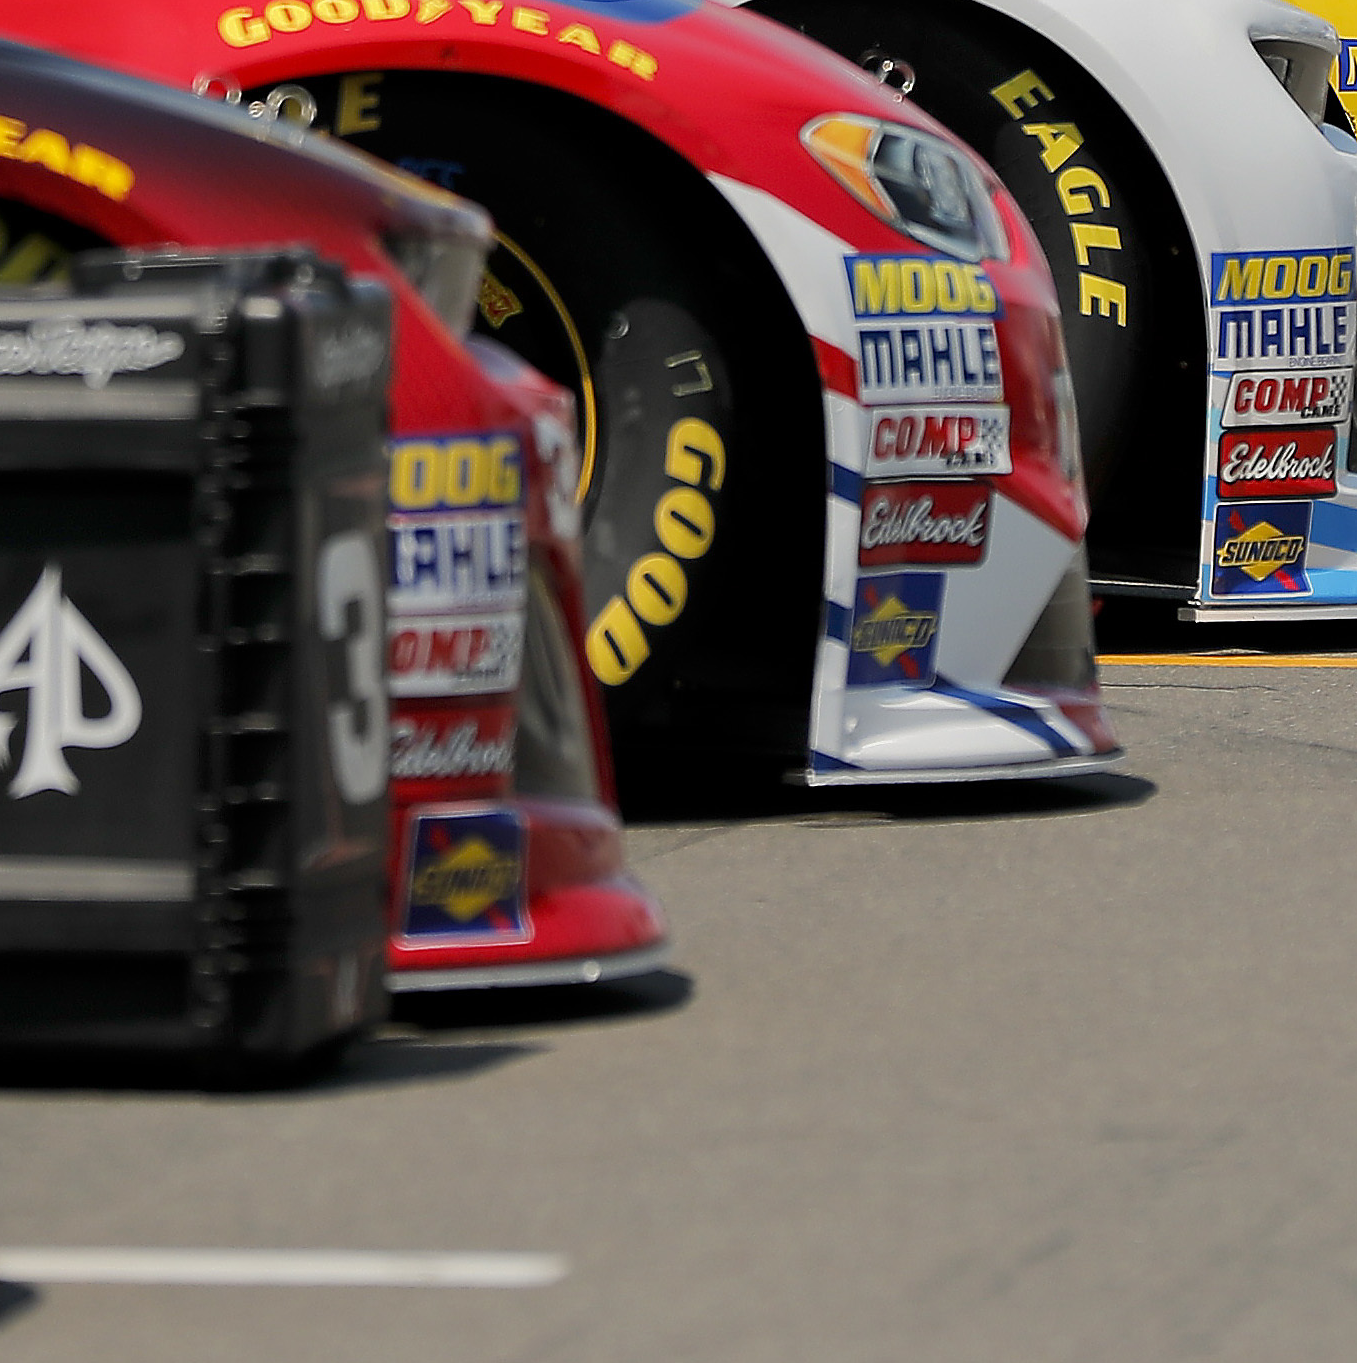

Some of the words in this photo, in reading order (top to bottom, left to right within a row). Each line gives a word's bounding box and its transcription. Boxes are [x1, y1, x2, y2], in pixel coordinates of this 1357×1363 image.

[990, 68, 1127, 328] EAGLE
[853, 260, 996, 315] MOOG
[1216, 254, 1352, 302] MOOG
[1218, 306, 1347, 358] MAHLE
[859, 329, 998, 389] MAHLE
[1234, 377, 1329, 415] COMP
[1301, 403, 1341, 420] CAMS
[874, 415, 980, 462] COMP
[1221, 439, 1333, 486] Edelbrock
[388, 438, 523, 509] OOG
[861, 494, 988, 550] Edelbrock
[390, 526, 523, 594] AHLE
[586, 416, 726, 687] GOOD
[1222, 538, 1303, 564] SUNOCO
[317, 539, 388, 805] 3
[390, 628, 489, 676] OMP
